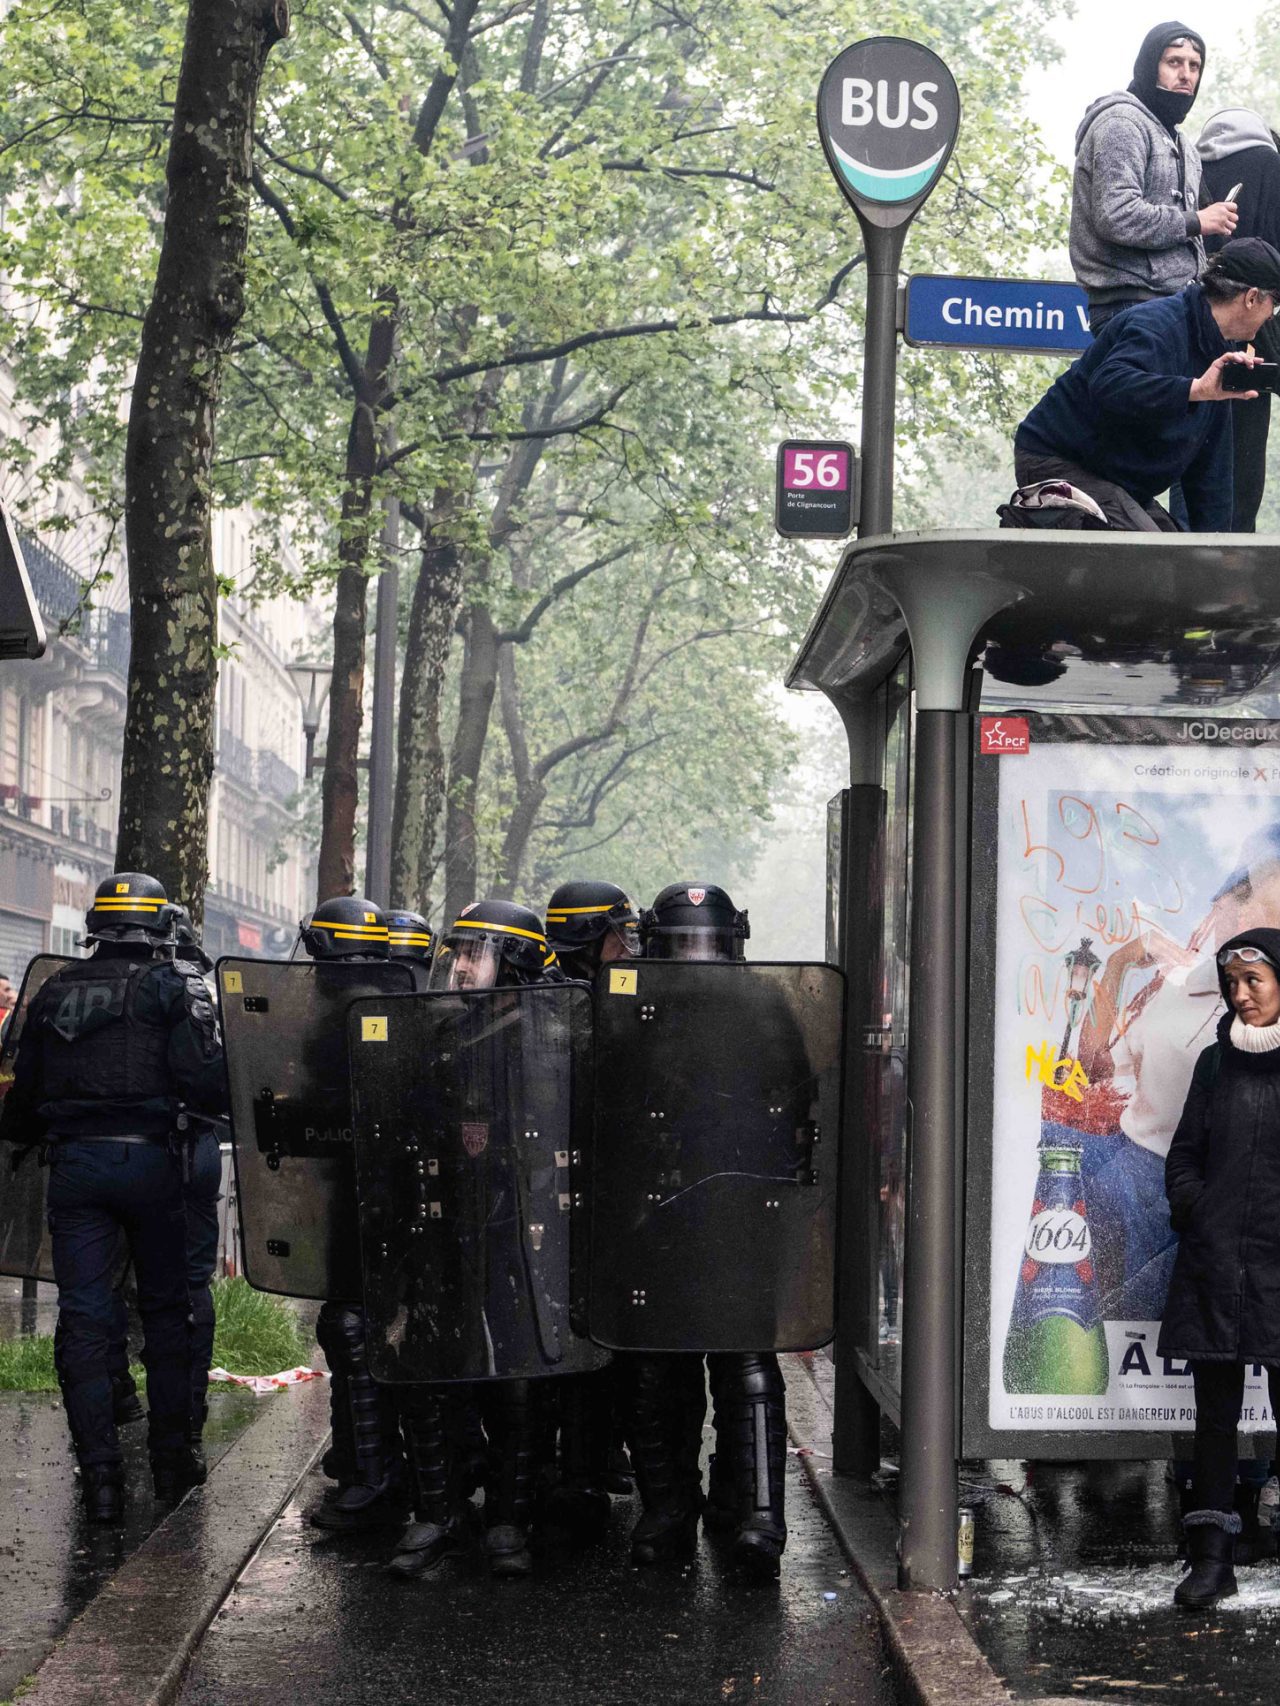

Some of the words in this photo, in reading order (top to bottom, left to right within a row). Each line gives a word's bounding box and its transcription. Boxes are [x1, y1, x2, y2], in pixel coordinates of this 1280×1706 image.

[842, 77, 938, 130] BUS
[941, 297, 1065, 331] Chemin
[792, 453, 840, 487] 56
[1176, 722, 1279, 741] JCDecaux
[1005, 737, 1026, 747] PCF
[1134, 764, 1190, 778] Création
[1194, 767, 1250, 781] originale
[229, 977, 236, 987] 7
[620, 976, 627, 987] 7
[371, 1023, 378, 1034] 7
[1028, 1216, 1088, 1252] 1664
[1010, 1407, 1043, 1420] L'ABUS
[1047, 1407, 1095, 1420] D'ALCOOL
[1097, 1407, 1116, 1420] EST
[1118, 1408, 1177, 1421] DANGEREUX
[1179, 1408, 1198, 1421] POU
[1261, 1405, 1268, 1421] À
